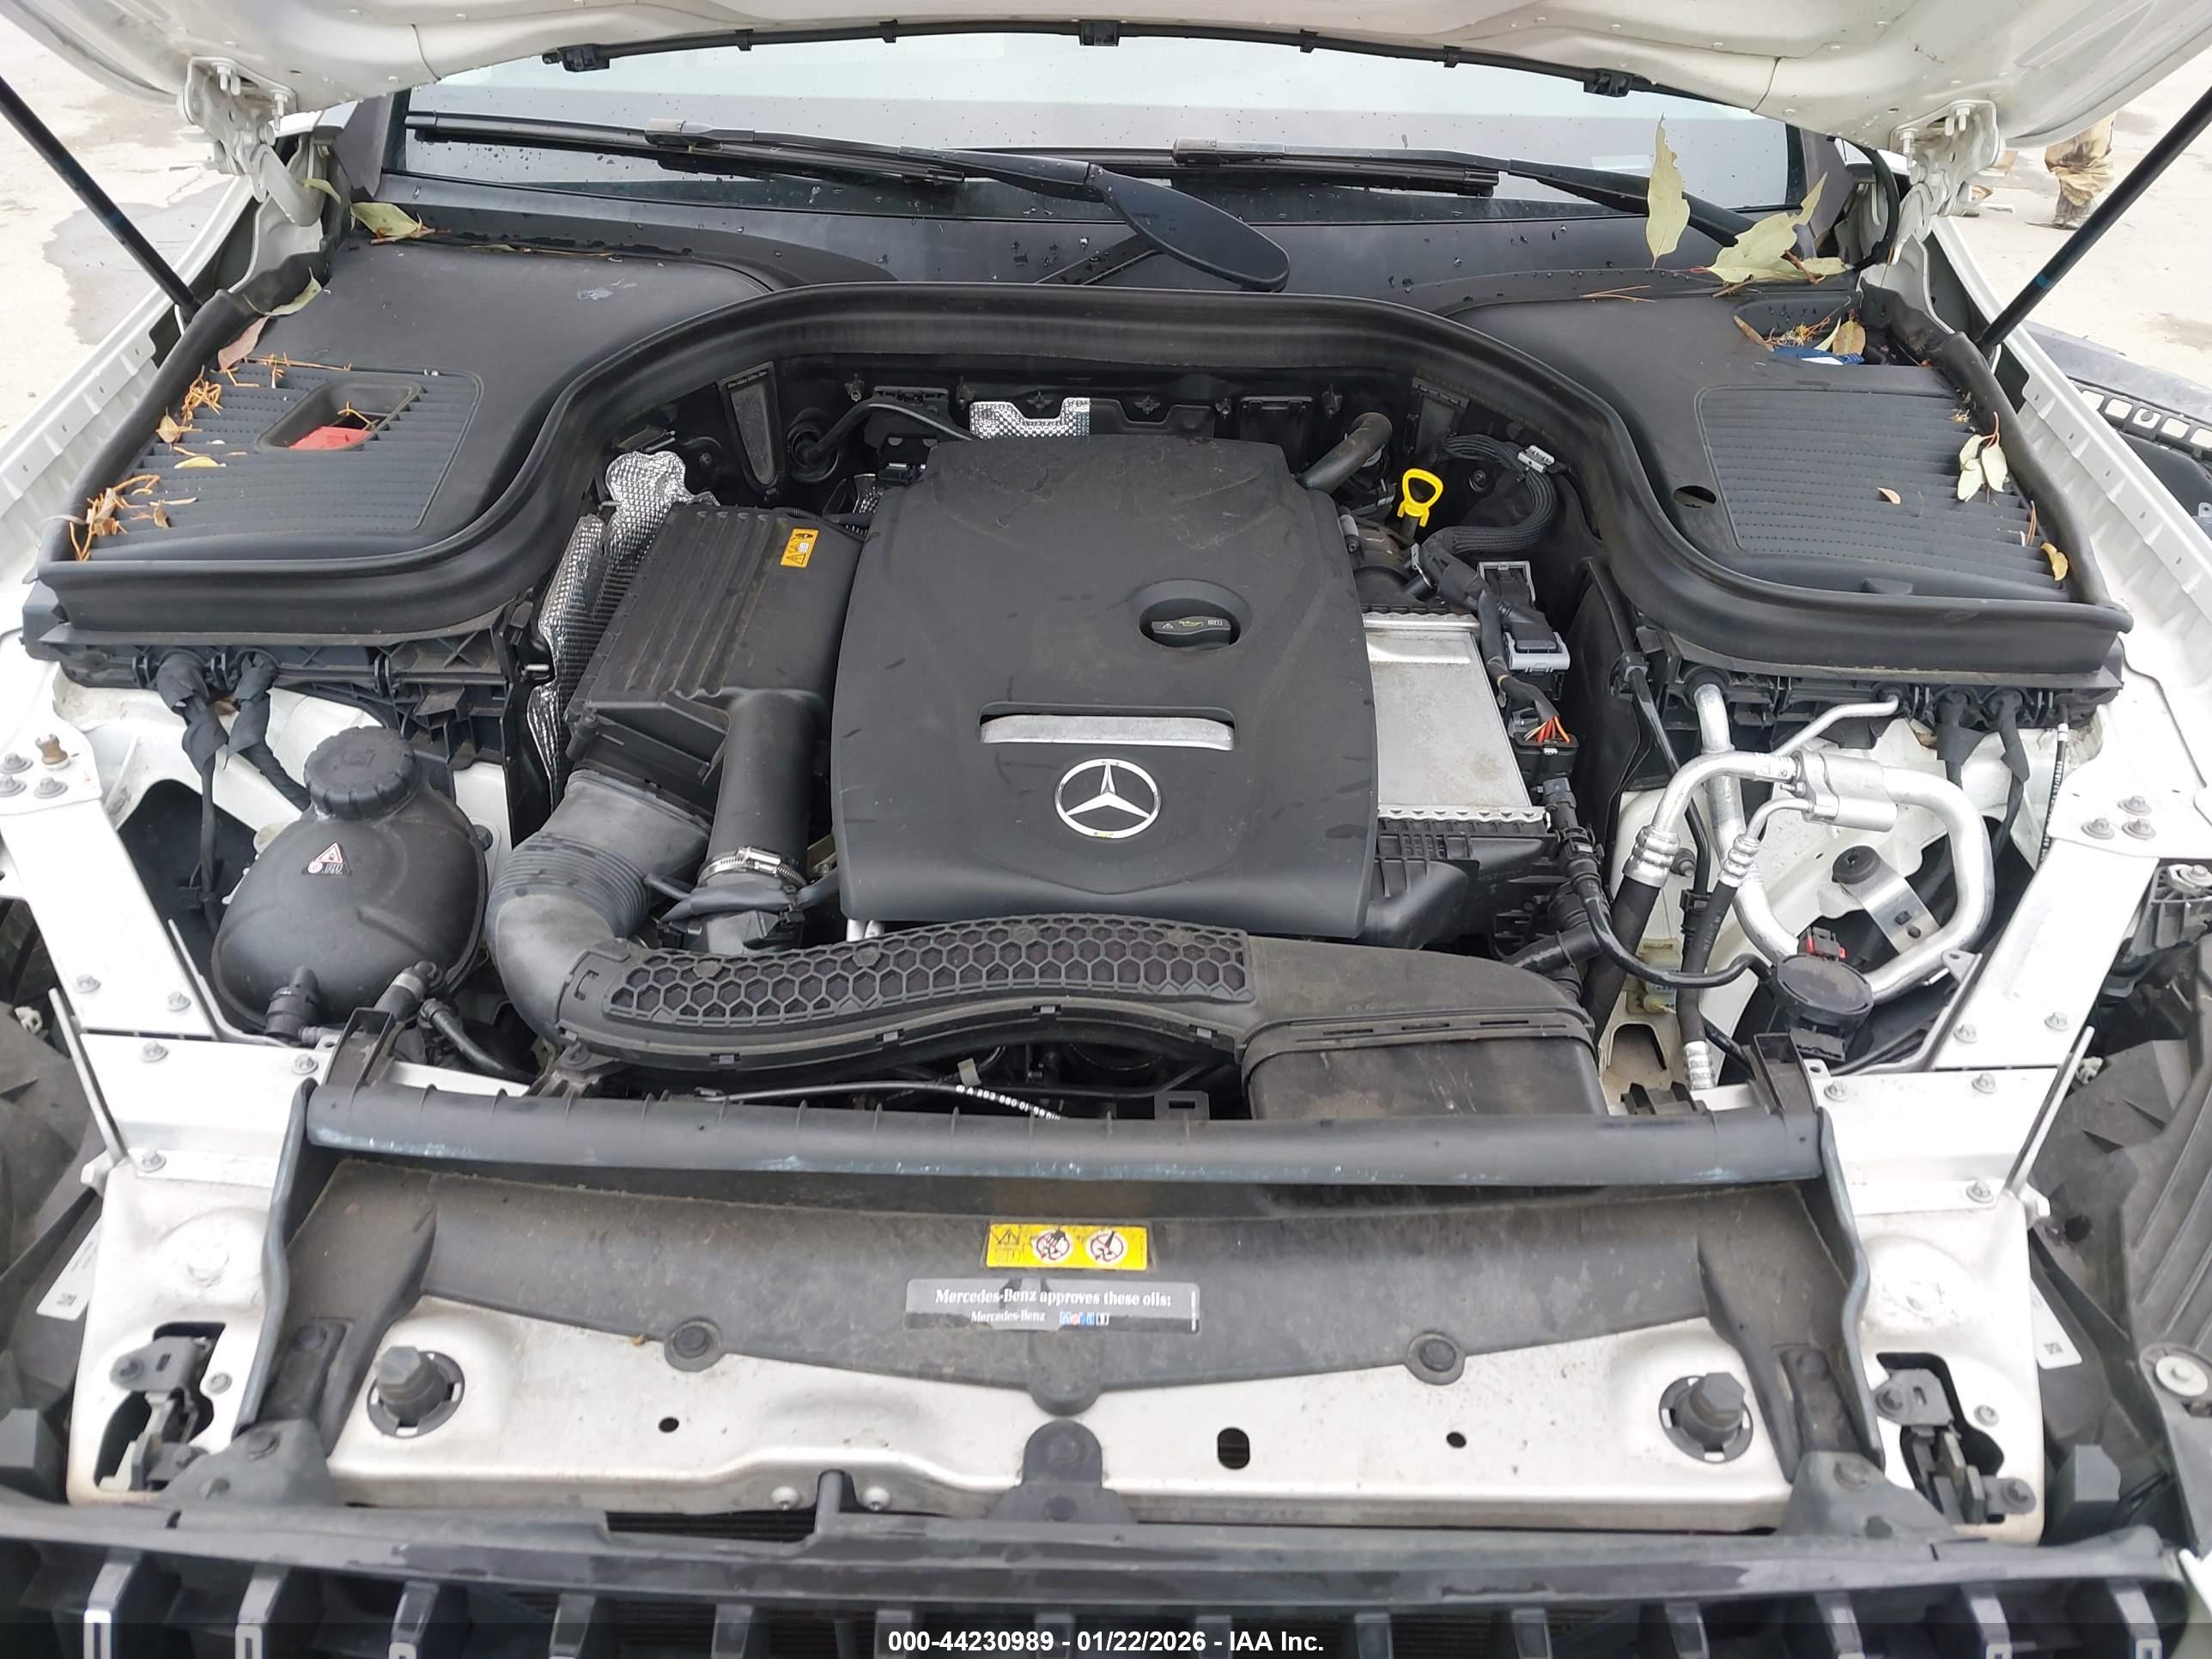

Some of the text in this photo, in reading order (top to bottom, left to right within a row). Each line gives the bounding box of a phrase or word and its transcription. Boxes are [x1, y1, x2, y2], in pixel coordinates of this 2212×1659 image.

[935, 1289, 1037, 1304] Mercedes-Benz
[1039, 1291, 1100, 1306] approves
[1103, 1291, 1139, 1306] these
[970, 1310, 1046, 1322] Mercedes-Benz
